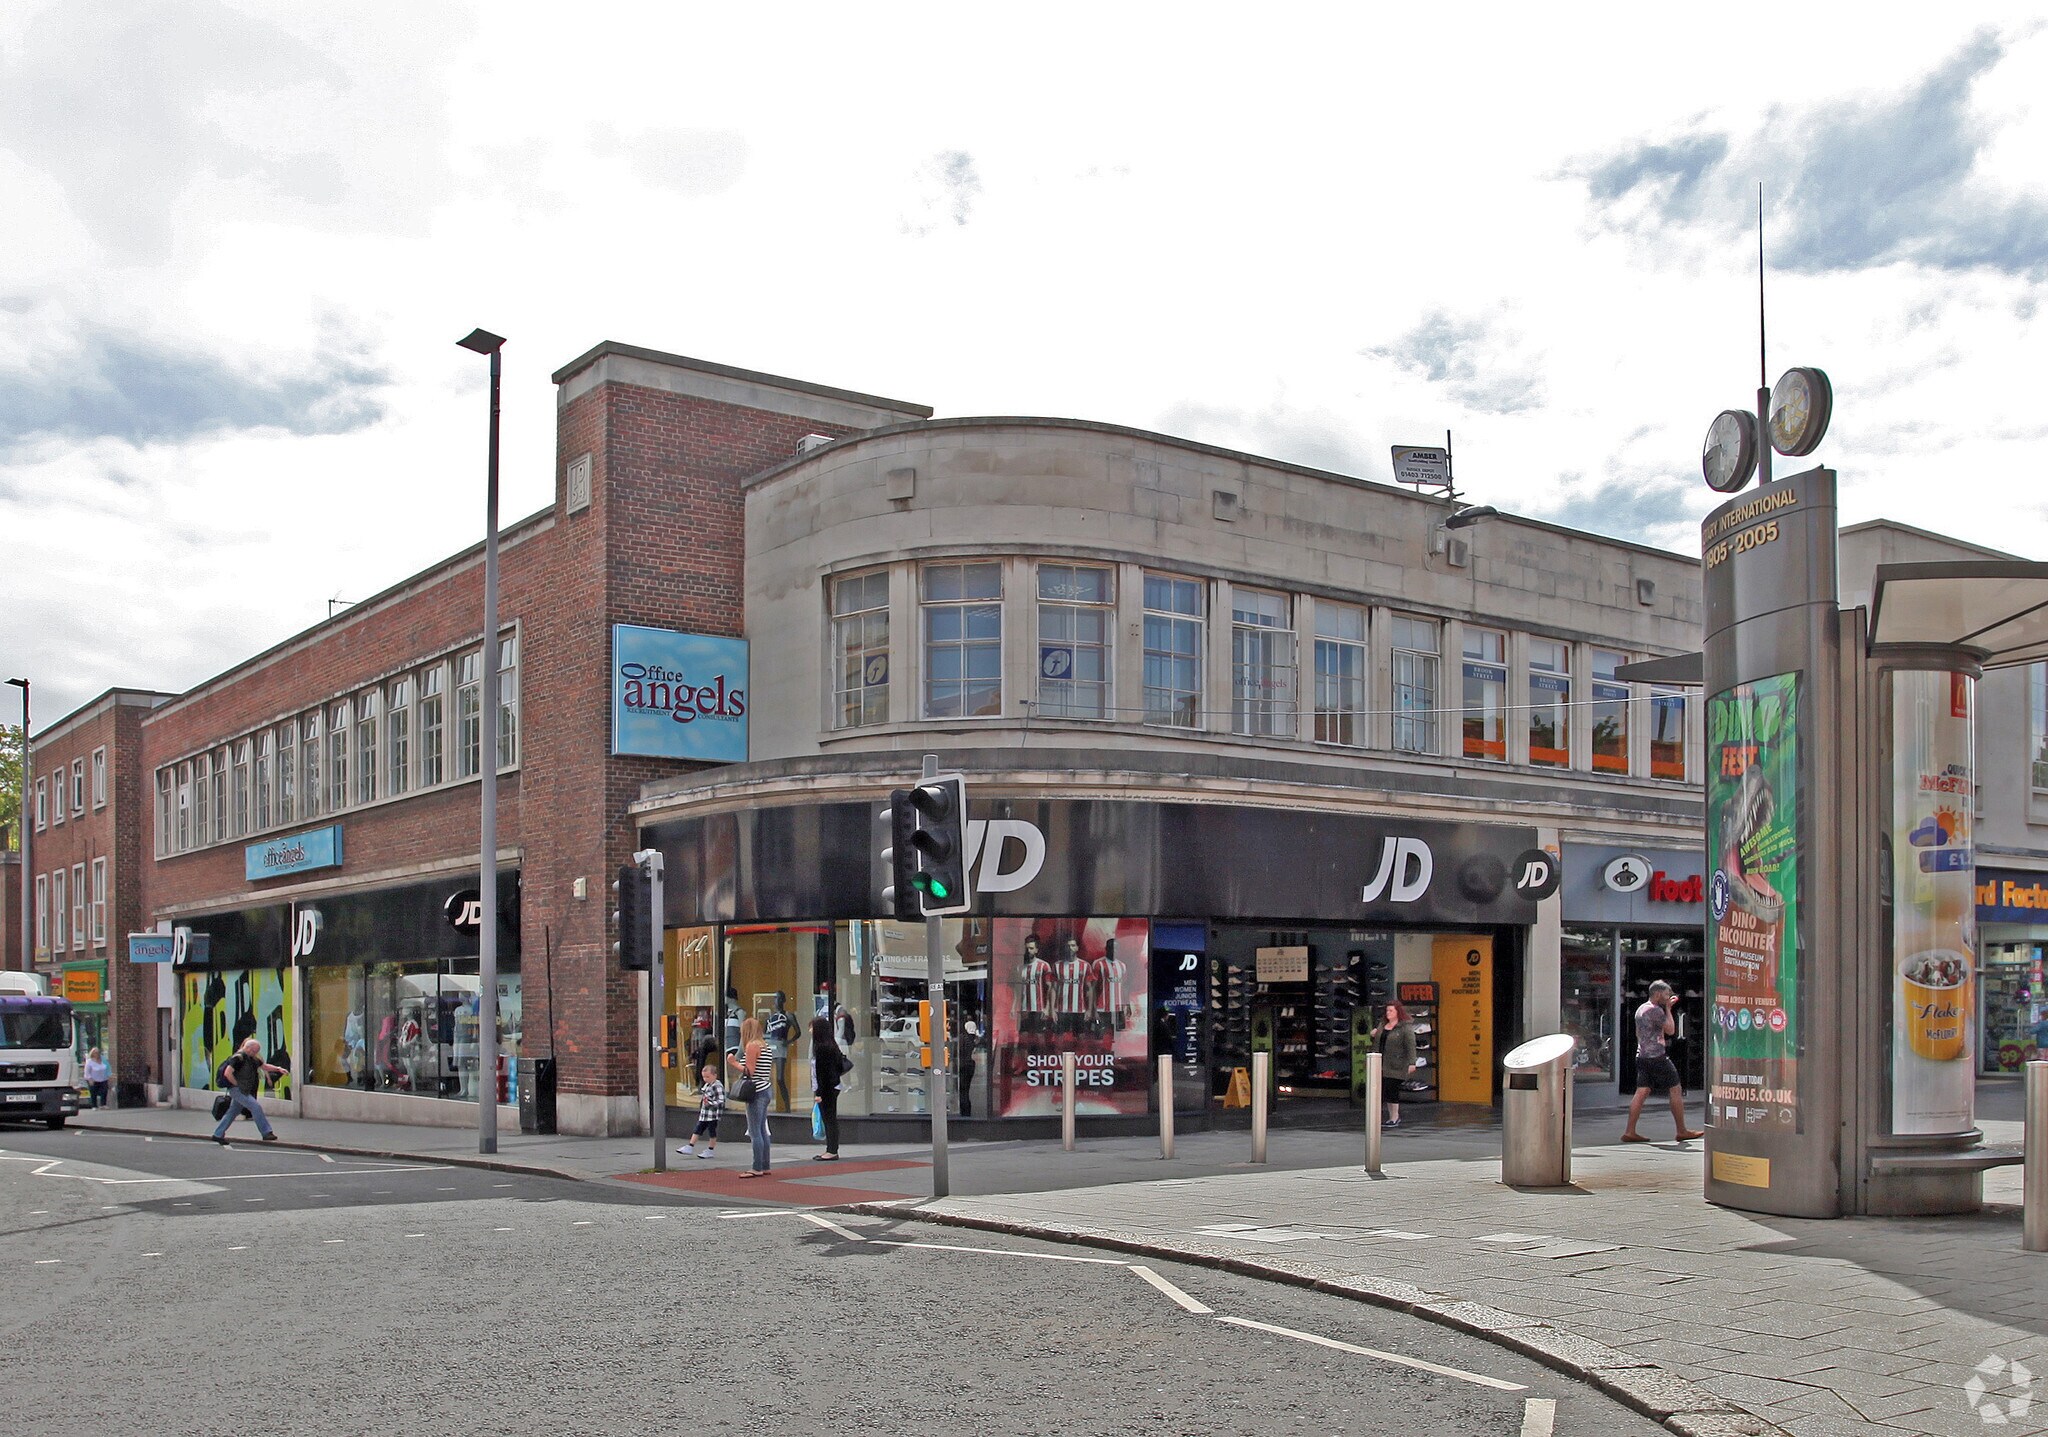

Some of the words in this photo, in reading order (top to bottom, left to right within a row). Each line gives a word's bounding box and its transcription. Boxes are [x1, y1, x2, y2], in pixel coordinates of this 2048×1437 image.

[1412, 452, 1437, 460] AMBER
[1721, 488, 1798, 531] INTERNATIONAL
[1735, 521, 1779, 554] 2005
[620, 662, 683, 682] Office
[623, 675, 745, 723] angels
[627, 708, 671, 717] RECRUITMENT
[697, 714, 739, 723] CONSULTANTS
[1708, 695, 1780, 744] DINO
[1722, 746, 1759, 776] FEST
[1740, 823, 1772, 858] AWESOME
[1362, 837, 1433, 902] JD
[1517, 861, 1549, 889] JD
[455, 901, 481, 926] JD
[1731, 910, 1757, 929] DINO
[292, 909, 317, 958] JD
[1719, 925, 1775, 952] ENCOUNTER
[134, 944, 170, 957] angels
[170, 927, 187, 965] JD
[1740, 951, 1764, 962] MUSEUM
[1179, 954, 1198, 970] JD
[1754, 997, 1776, 1006] VENUES
[1920, 1001, 1958, 1019] Flake
[1075, 1054, 1115, 1067] YOUR
[1026, 1069, 1115, 1086] STRPES
[1748, 1075, 1763, 1085] TODAY
